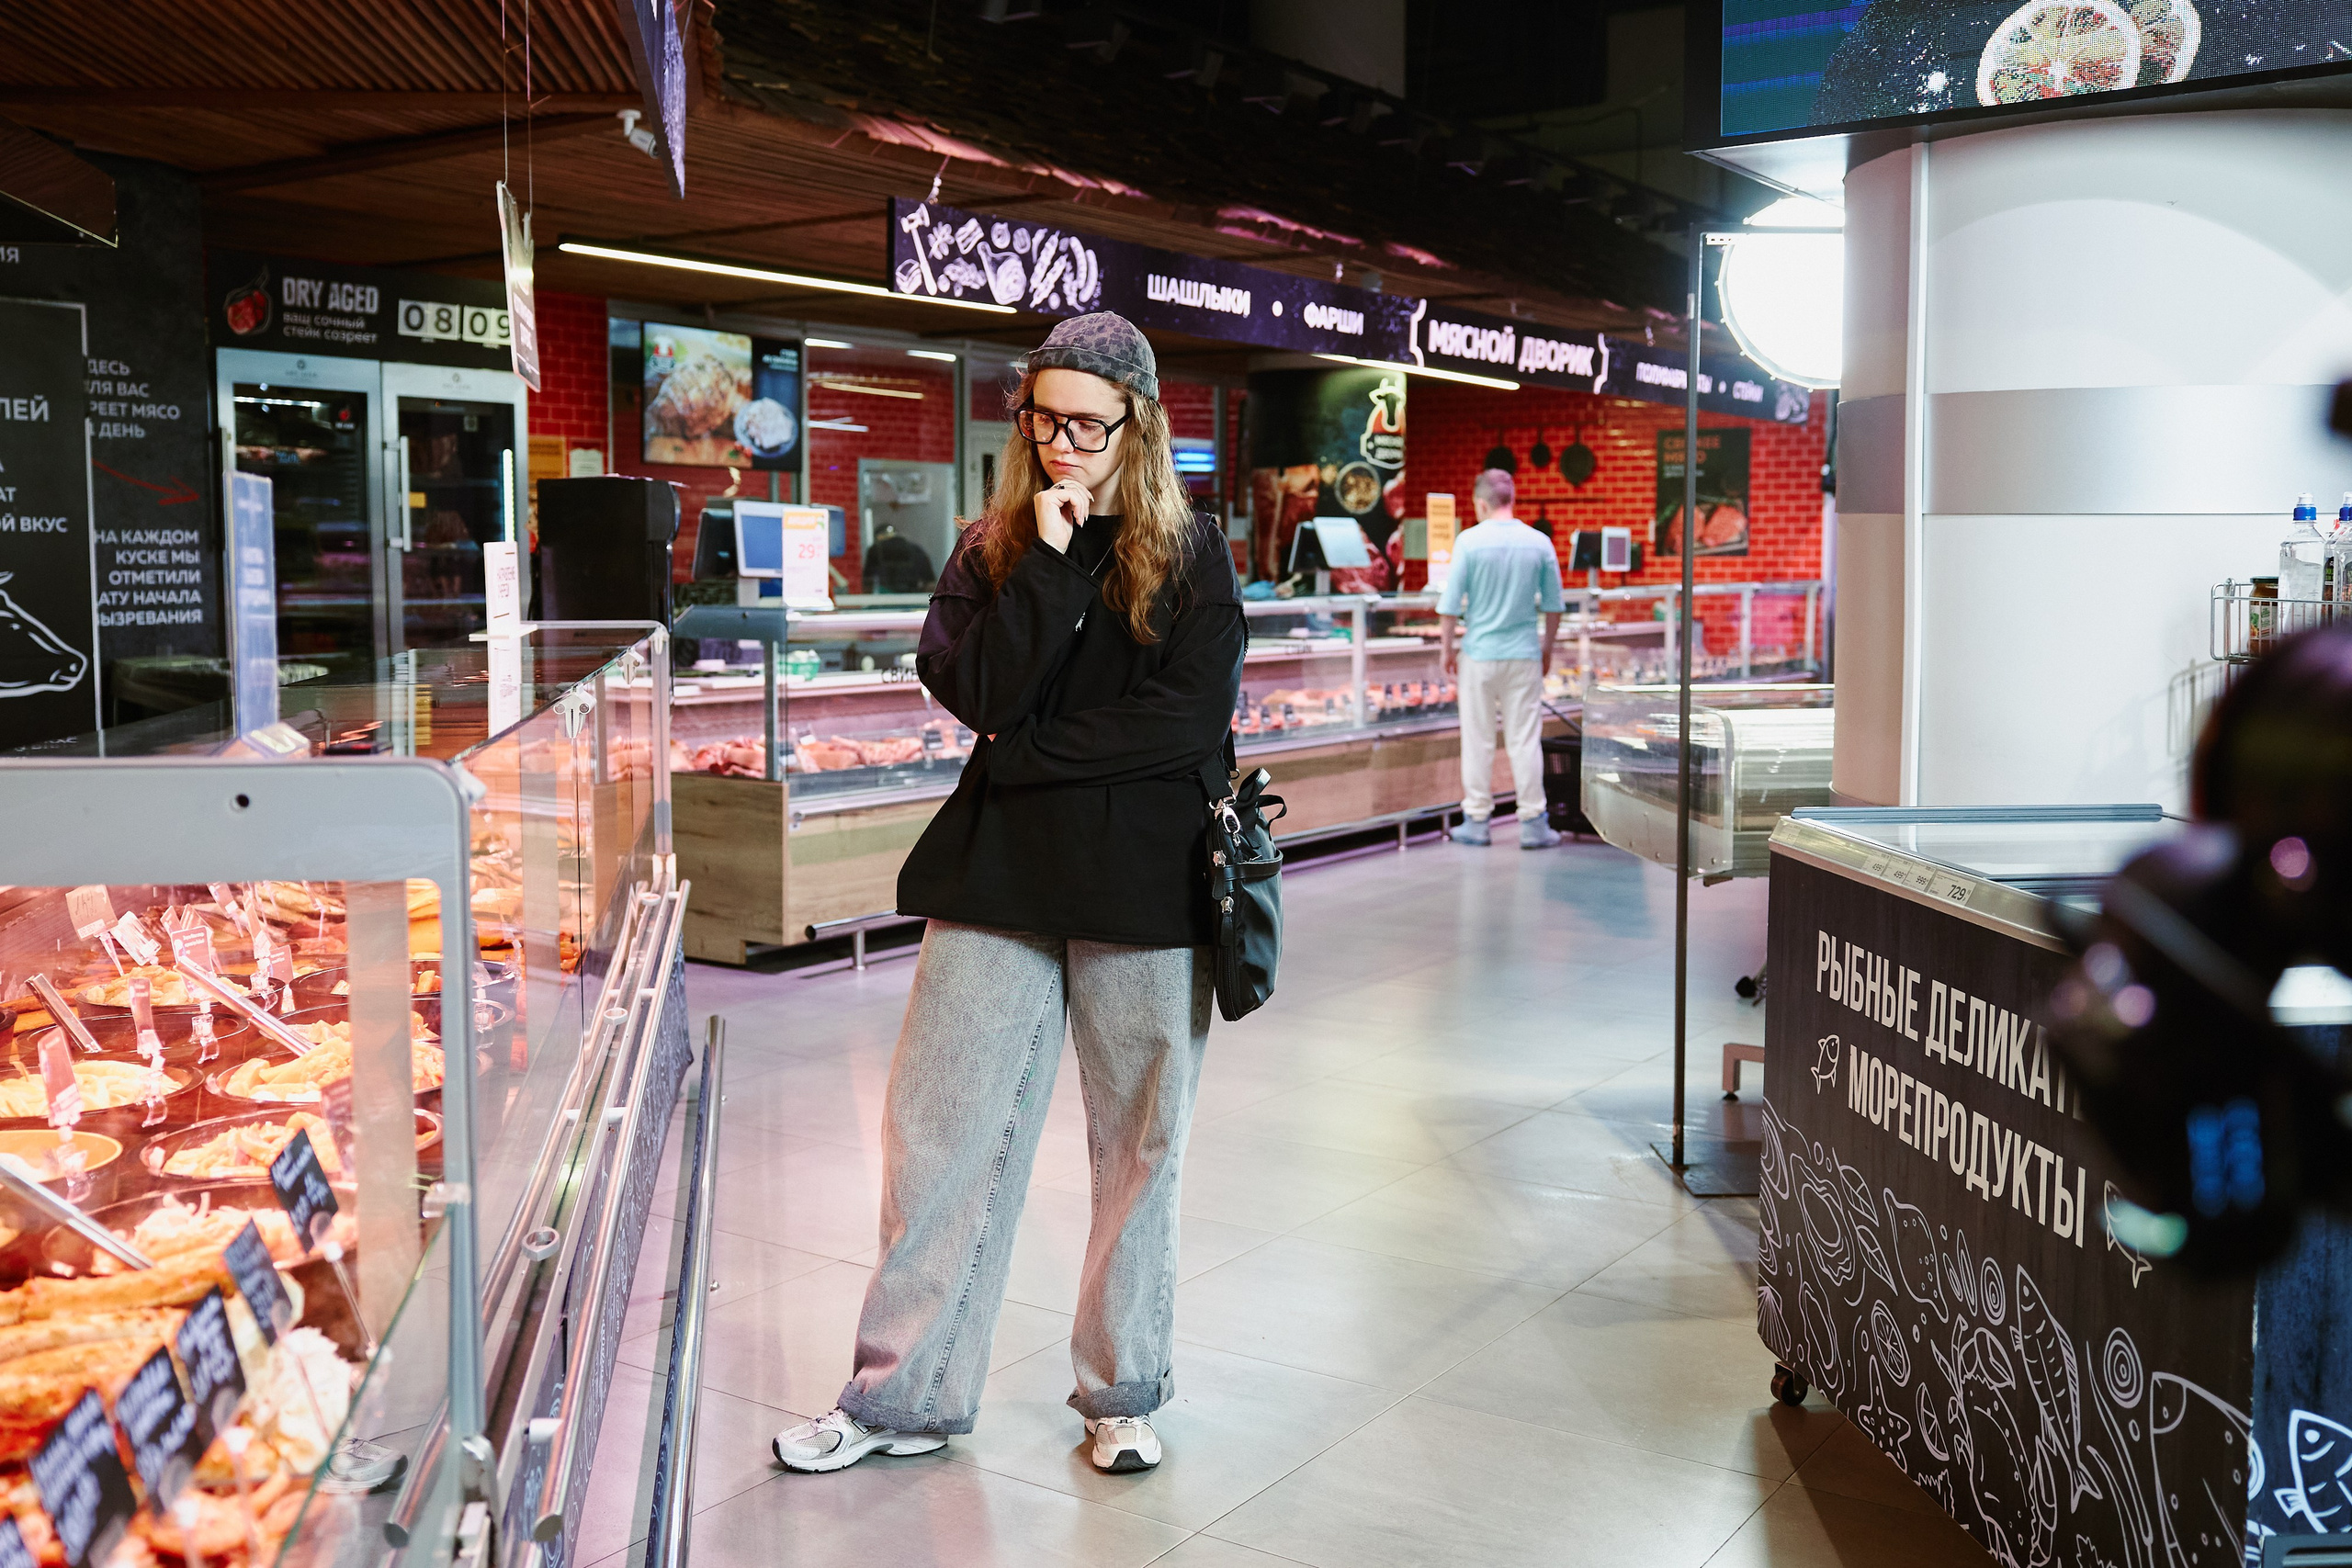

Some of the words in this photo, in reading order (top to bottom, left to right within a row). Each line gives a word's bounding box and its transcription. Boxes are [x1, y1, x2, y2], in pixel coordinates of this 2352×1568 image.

[282, 276, 323, 309] DRY
[327, 284, 379, 314] AGED
[1147, 273, 1251, 316] ШАШЛЫКИ
[1303, 301, 1364, 335] ФАРШИ
[282, 311, 311, 325] ваш
[313, 315, 366, 330] сочный
[282, 325, 321, 338] стейк
[323, 330, 378, 344] созреет
[1428, 319, 1515, 365] МЯСНОЙ
[1518, 335, 1595, 378] ДВОРИК
[87, 358, 130, 376] ДЕСЬ
[87, 380, 112, 395] ЛЯ
[117, 382, 149, 398] ВАС
[131, 402, 181, 420] МЯСО
[98, 422, 145, 439] ДЕНЬ
[20, 516, 67, 533] ВКУС
[95, 529, 119, 544] НА
[121, 529, 199, 547] КАЖДОМ
[116, 550, 169, 565] КУСКЕ
[172, 549, 200, 564] МЫ
[798, 544, 815, 558] 29
[108, 569, 202, 585] ОТМЕТИЛИ
[98, 591, 130, 606] АТУ
[133, 589, 202, 605] НАЧАЛА
[98, 608, 203, 627] ЫЗРЕВАНИЯ
[1947, 885, 1967, 901] 729
[1816, 930, 1921, 1042] РЫБНЫЕ
[1925, 979, 2084, 1121] ДЕЛИКА
[1848, 1044, 2086, 1247] МОРЕПРОДУКТЫ
